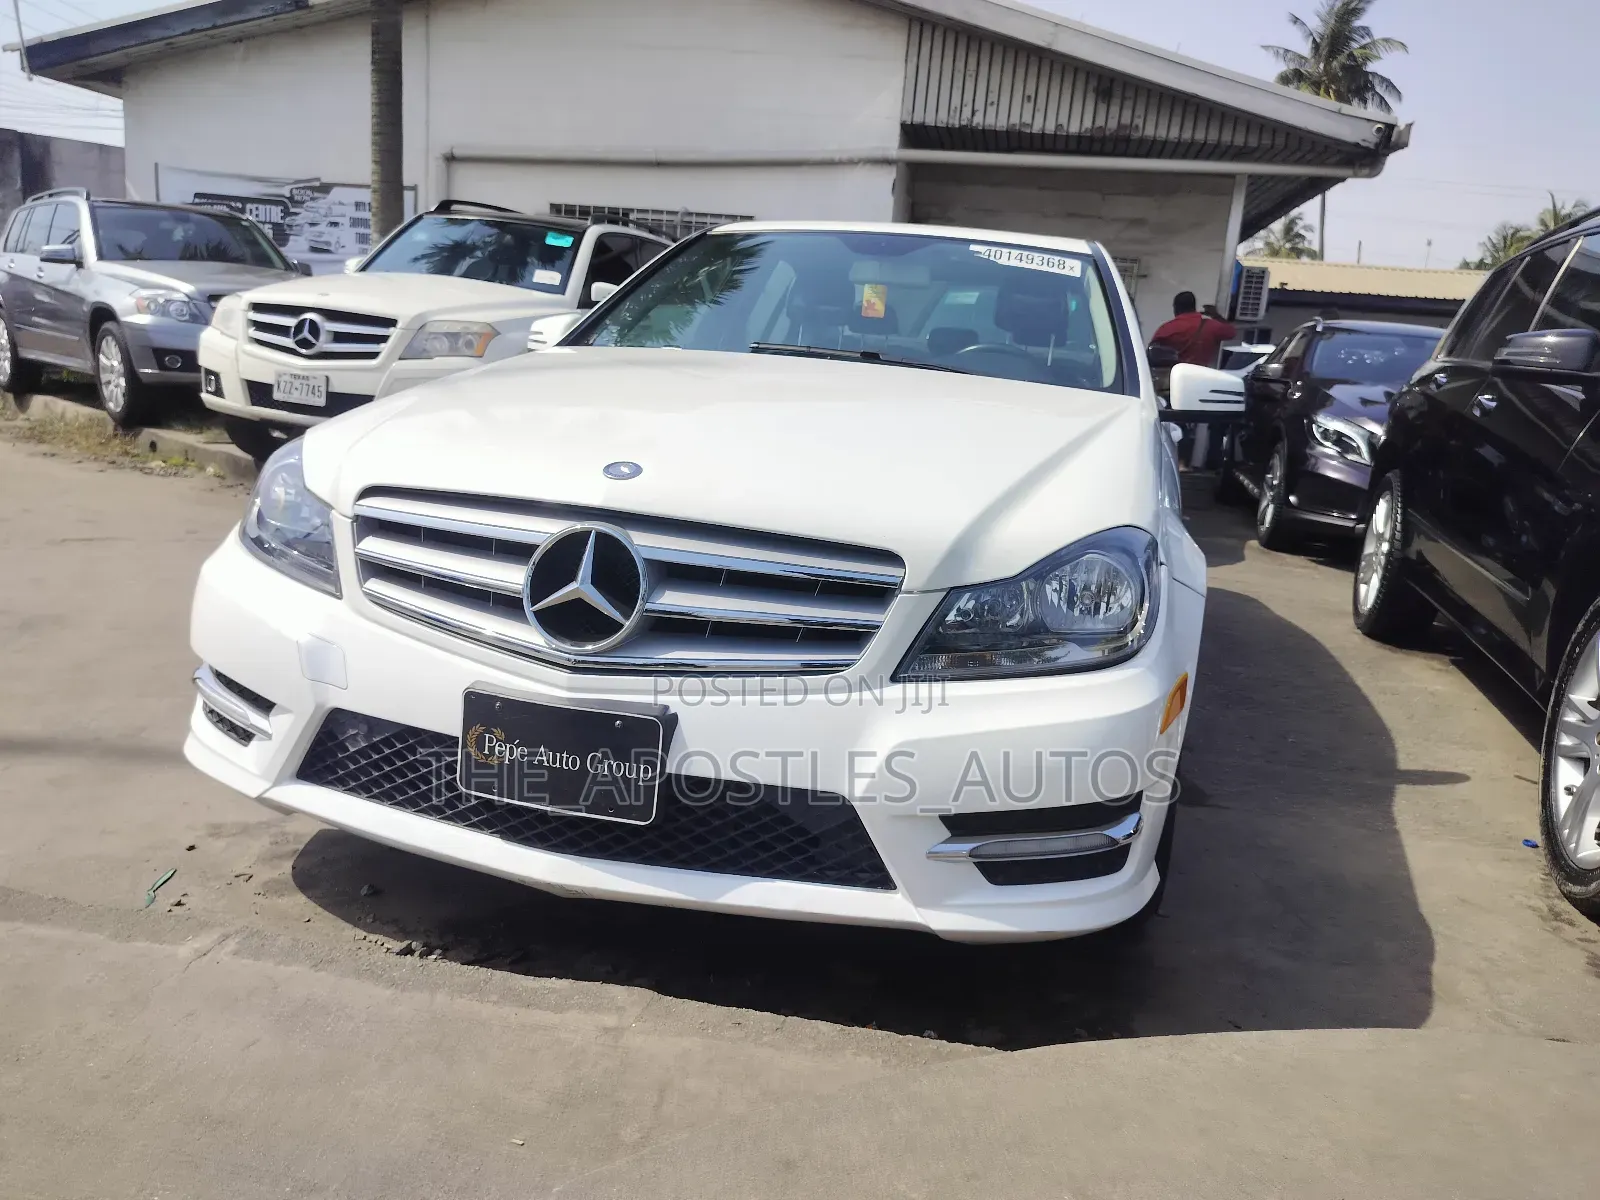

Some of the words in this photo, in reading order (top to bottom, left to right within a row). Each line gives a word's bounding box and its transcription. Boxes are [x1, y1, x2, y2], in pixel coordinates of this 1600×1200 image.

[290, 373, 309, 381] TEXAS
[483, 733, 528, 764] Pepé
[533, 744, 580, 771] Auto
[586, 752, 652, 786] Group
